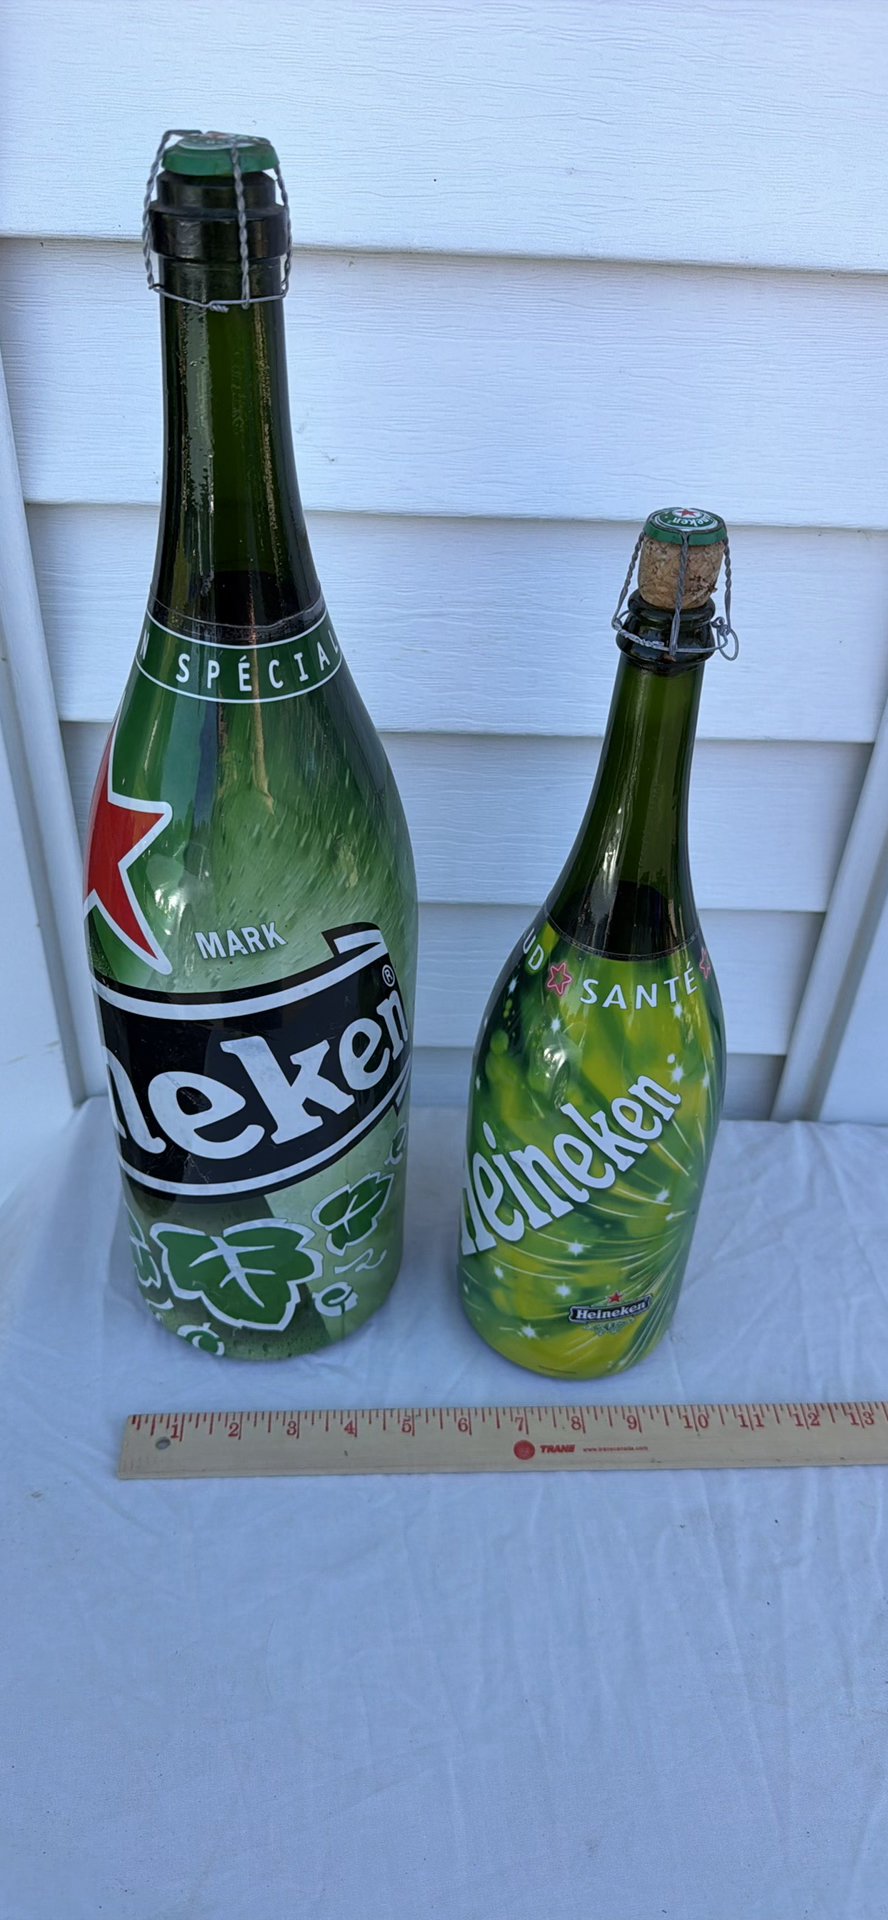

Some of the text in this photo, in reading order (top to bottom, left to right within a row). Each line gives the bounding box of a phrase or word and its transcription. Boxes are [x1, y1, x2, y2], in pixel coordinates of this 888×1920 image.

[194, 921, 288, 960] MARK
[580, 961, 698, 1010] SANTÉ
[576, 1301, 646, 1320] Heineken
[170, 1411, 875, 1439] 1 2 3 4 5 6 7 8 9 10 11 12 13
[540, 1444, 576, 1454] TRANE
